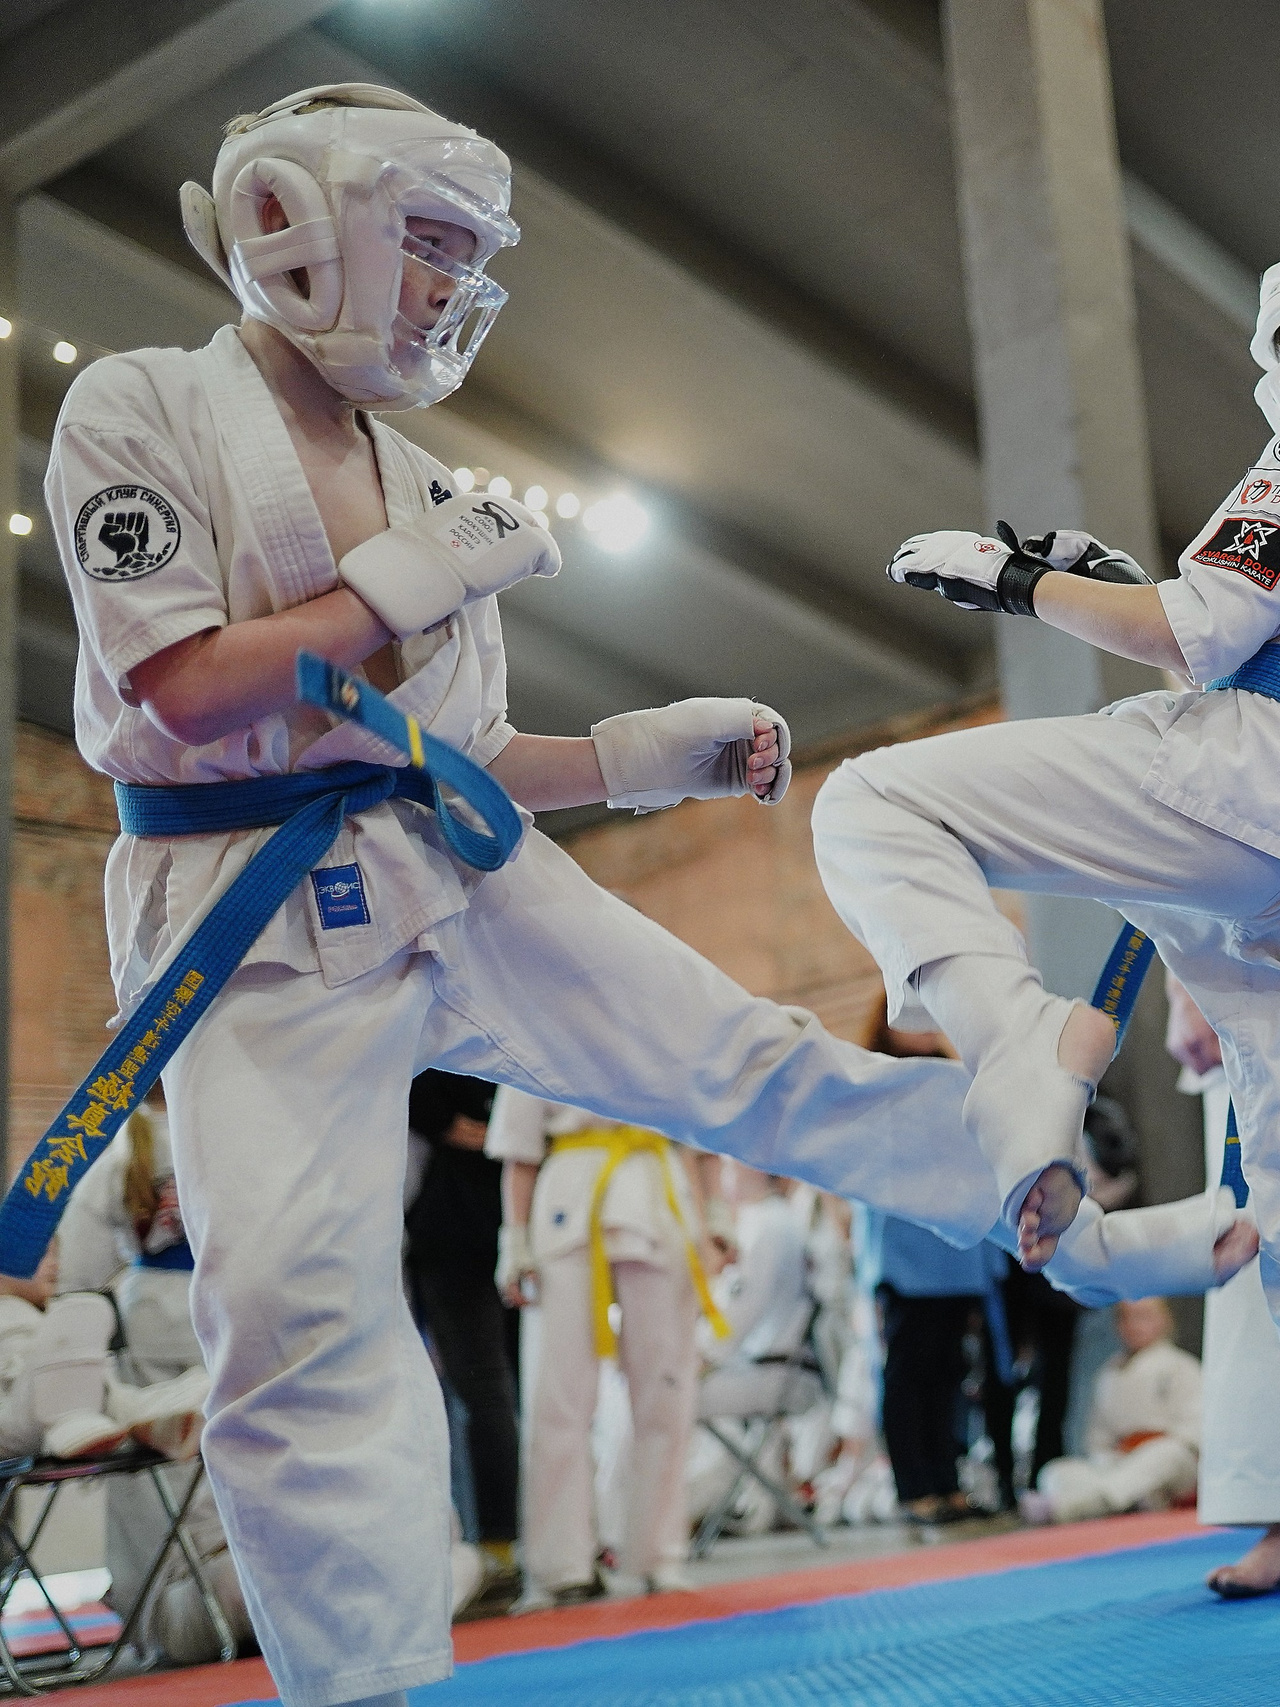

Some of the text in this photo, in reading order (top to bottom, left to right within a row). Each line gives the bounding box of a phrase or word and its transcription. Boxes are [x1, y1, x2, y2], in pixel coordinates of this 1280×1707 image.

[105, 488, 138, 502] КЛУБ
[139, 491, 177, 534] СИНЕРГИЯ
[474, 515, 494, 534] СОЮЗ
[449, 528, 475, 551] РОССИИ
[457, 523, 481, 545] КАРАТЭ
[458, 514, 495, 546] КИОКУШИН
[1195, 554, 1272, 586] KIOKUSHIN KARATE
[1200, 551, 1275, 579] SVARGA DOJO
